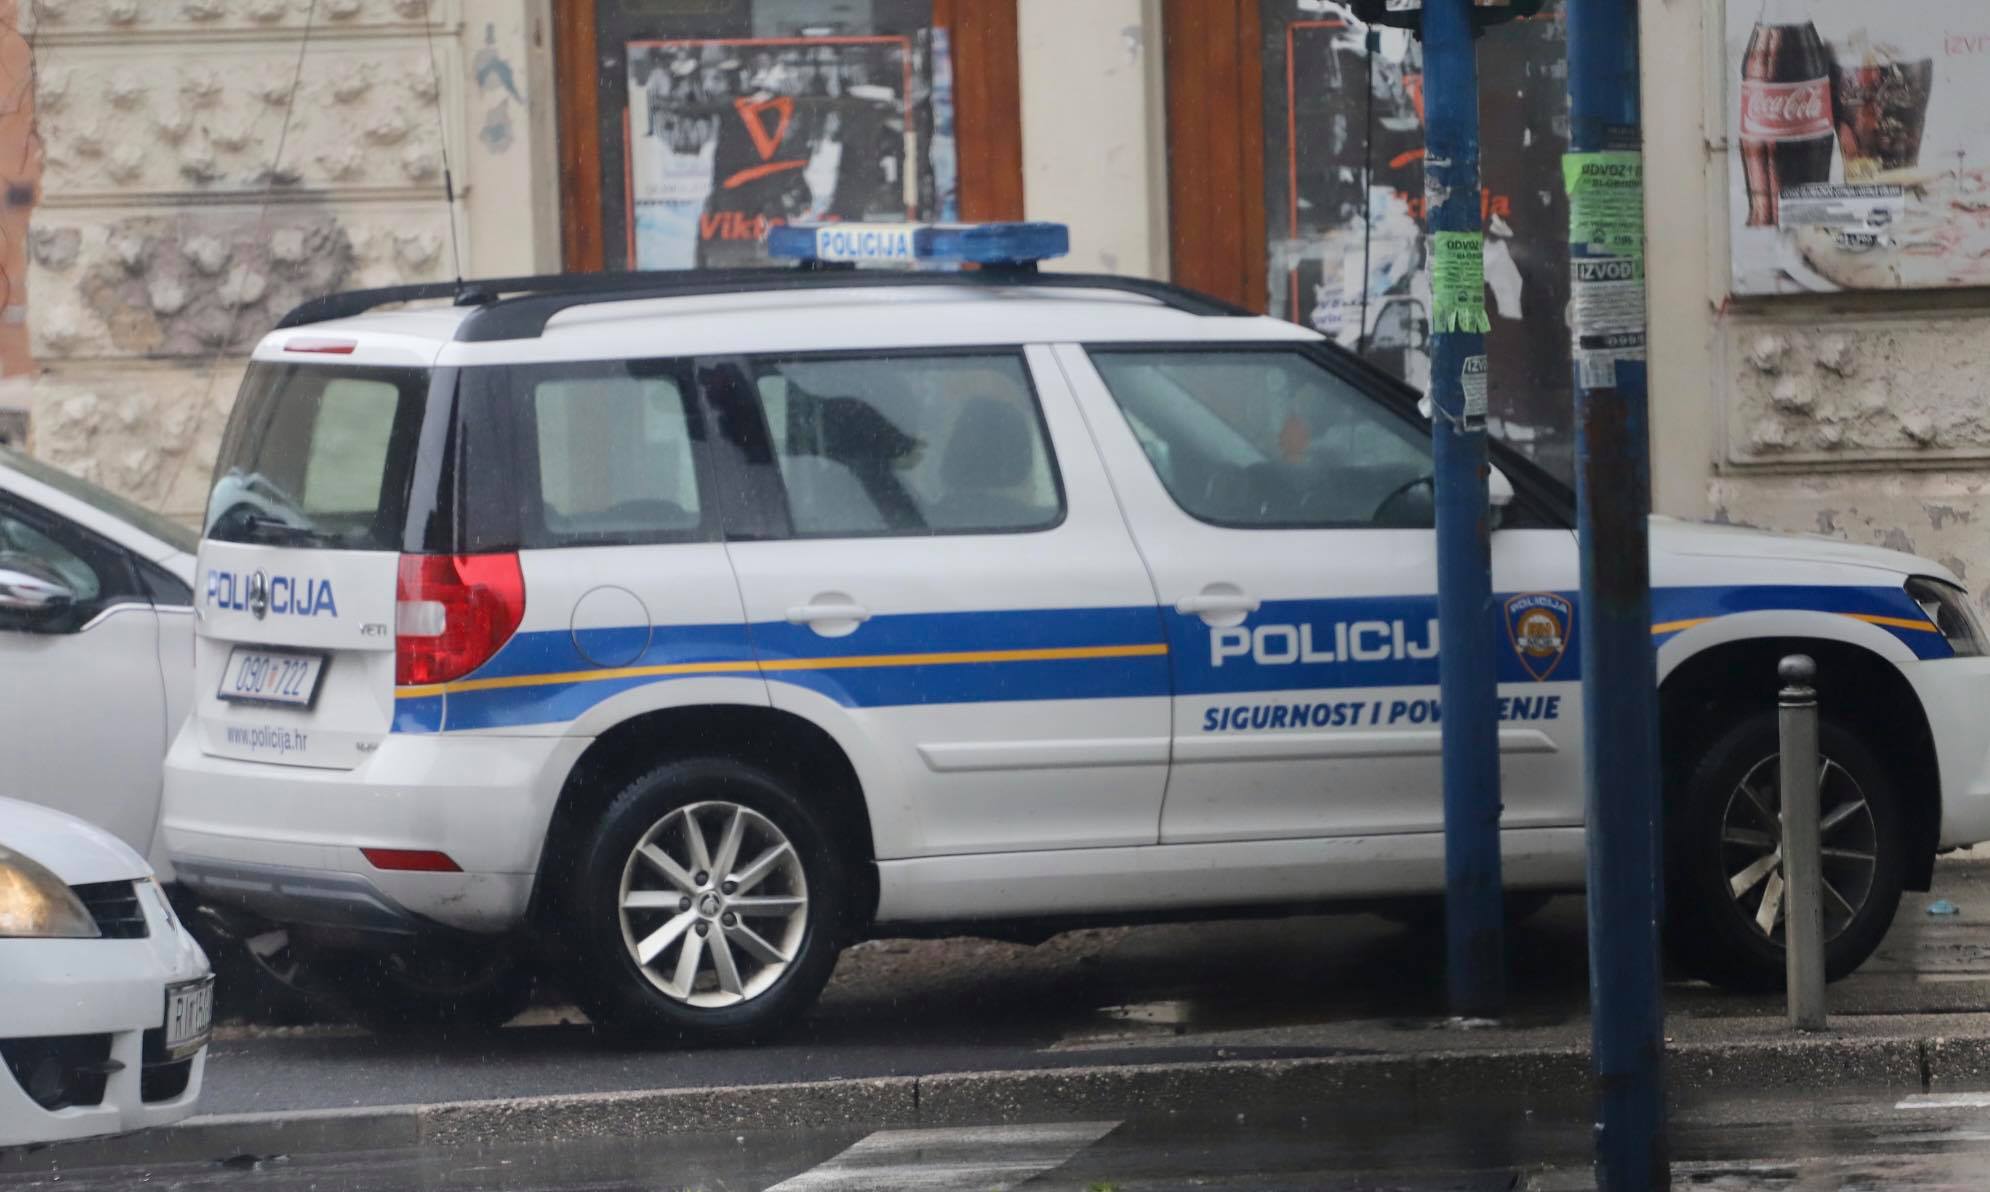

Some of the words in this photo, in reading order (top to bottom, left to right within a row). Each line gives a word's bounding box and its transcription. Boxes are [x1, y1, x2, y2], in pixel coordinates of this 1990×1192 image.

[822, 231, 907, 256] POLICIJA
[207, 569, 338, 618] POLICIJA
[1509, 596, 1569, 613] POLICIJA
[1209, 618, 1440, 667] POLICIJ
[1203, 703, 1364, 731] SIGURNOST
[1370, 702, 1382, 724] I
[226, 726, 308, 755] www.policija.hr
